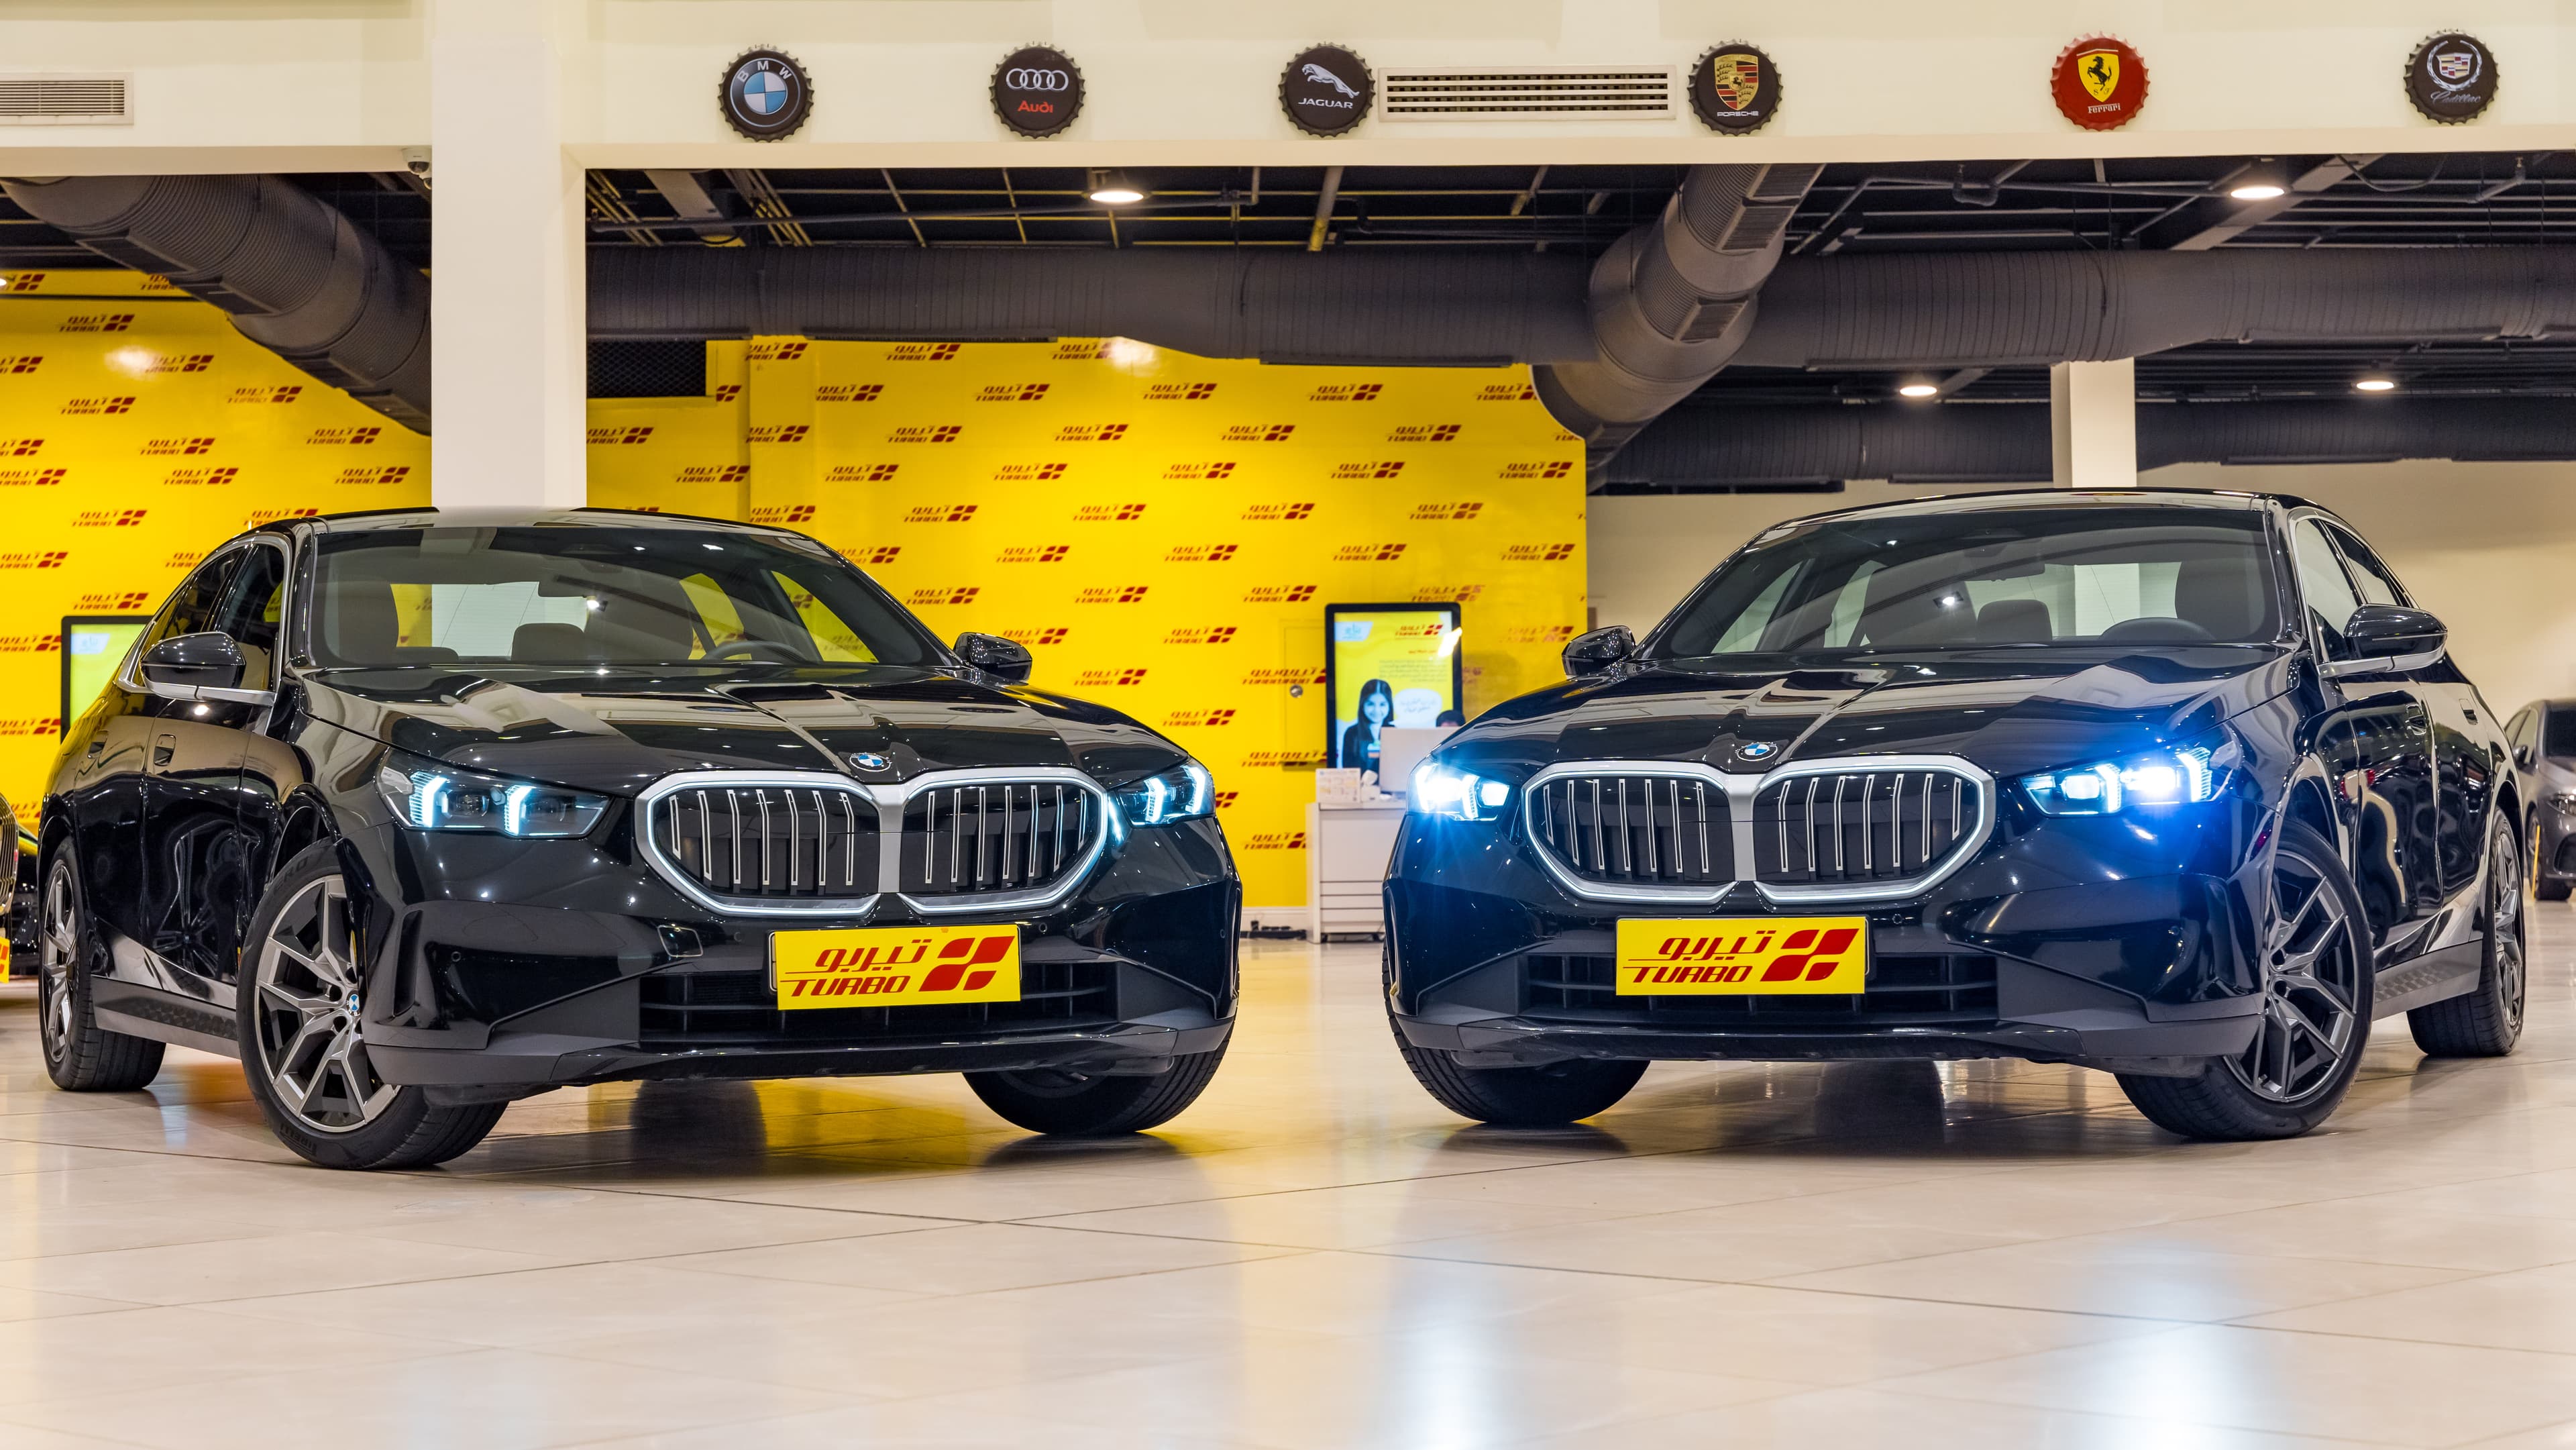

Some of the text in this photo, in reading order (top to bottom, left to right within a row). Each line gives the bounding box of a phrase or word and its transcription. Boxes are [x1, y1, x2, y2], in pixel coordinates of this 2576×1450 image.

[737, 60, 792, 83] BMW
[1017, 100, 1053, 113] Audi
[1298, 97, 1353, 109] JAGUAR
[2088, 103, 2121, 113] Ferrari
[1623, 966, 1753, 983] TURBO
[780, 975, 911, 996] TURBO
